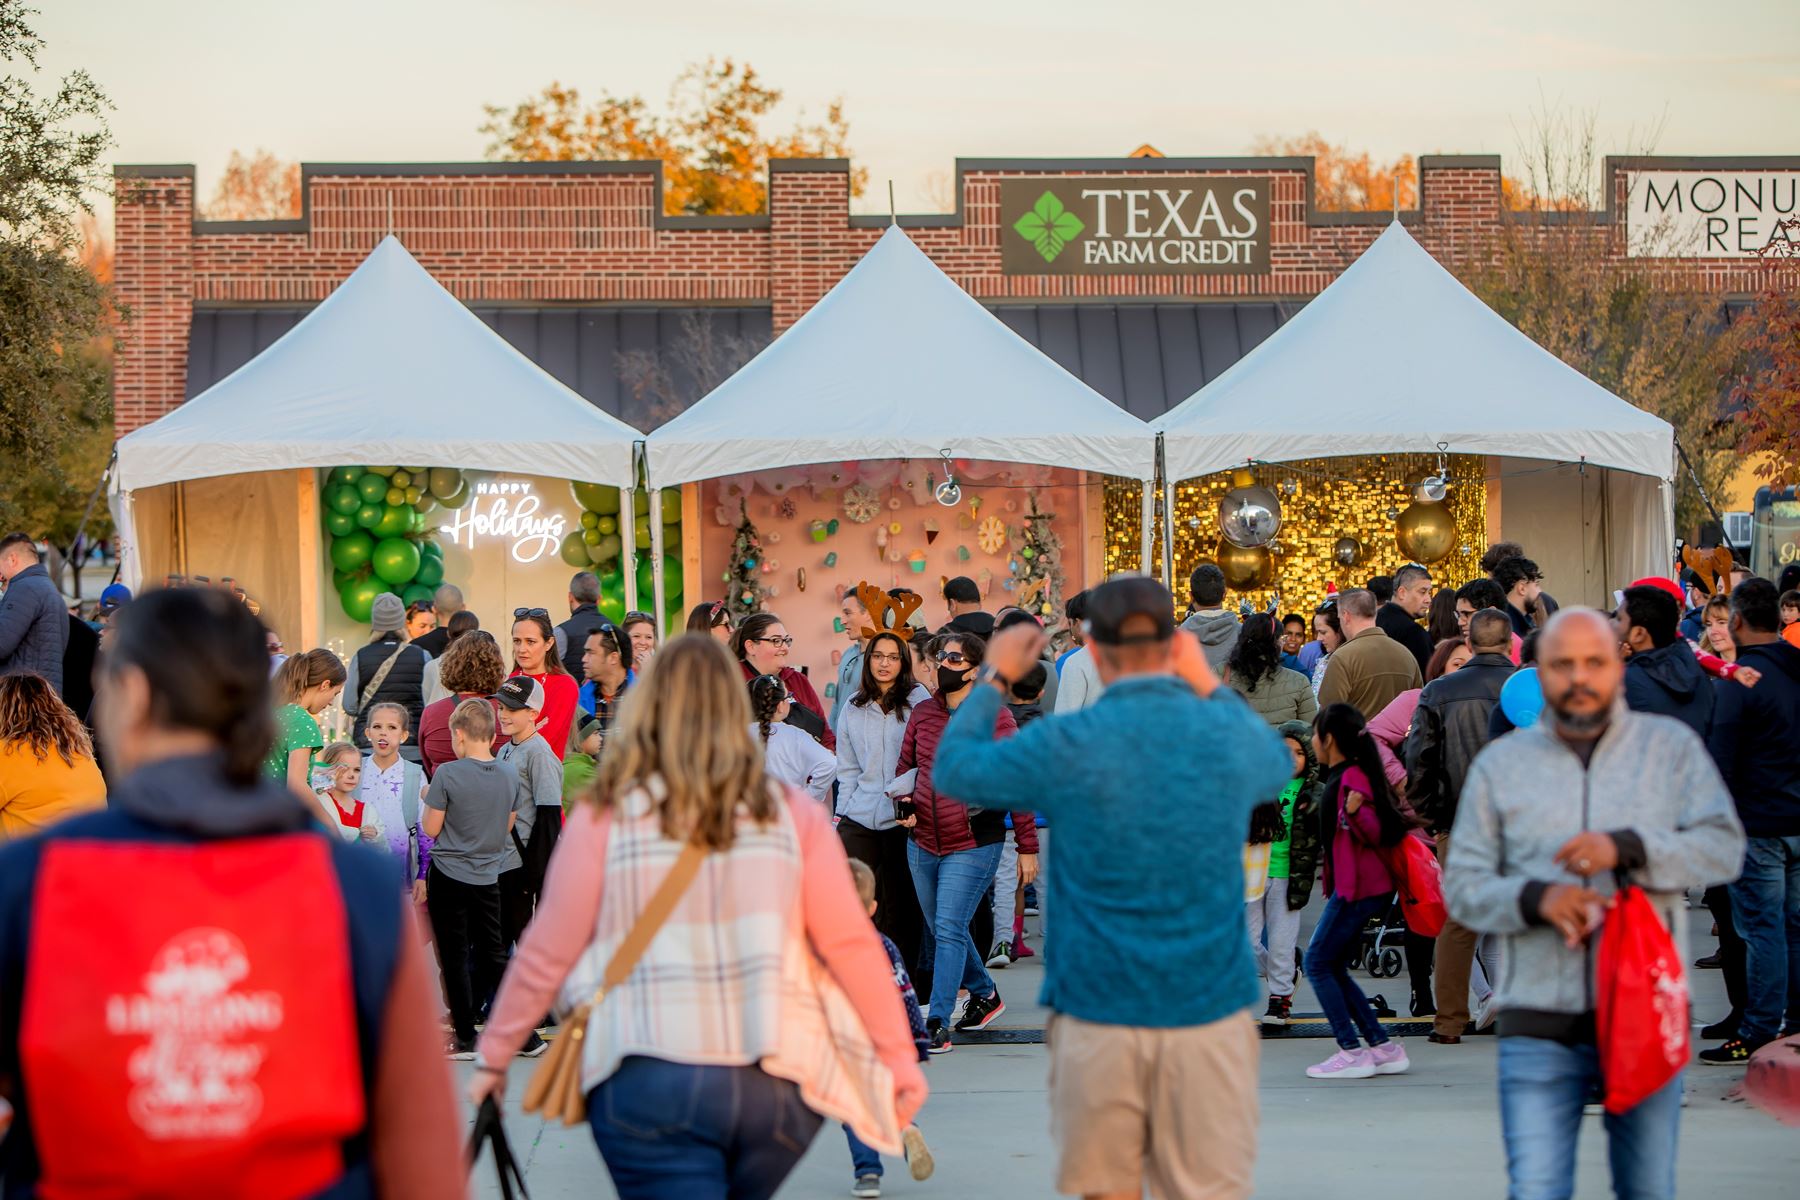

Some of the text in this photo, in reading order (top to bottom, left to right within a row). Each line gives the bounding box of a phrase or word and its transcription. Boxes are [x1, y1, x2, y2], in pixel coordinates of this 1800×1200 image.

[1081, 188, 1258, 238] TEXAS
[1645, 177, 1796, 214] MONU
[1083, 240, 1257, 264] FARM CREDIT
[477, 483, 531, 495] HAPPY
[440, 495, 566, 563] Holidays
